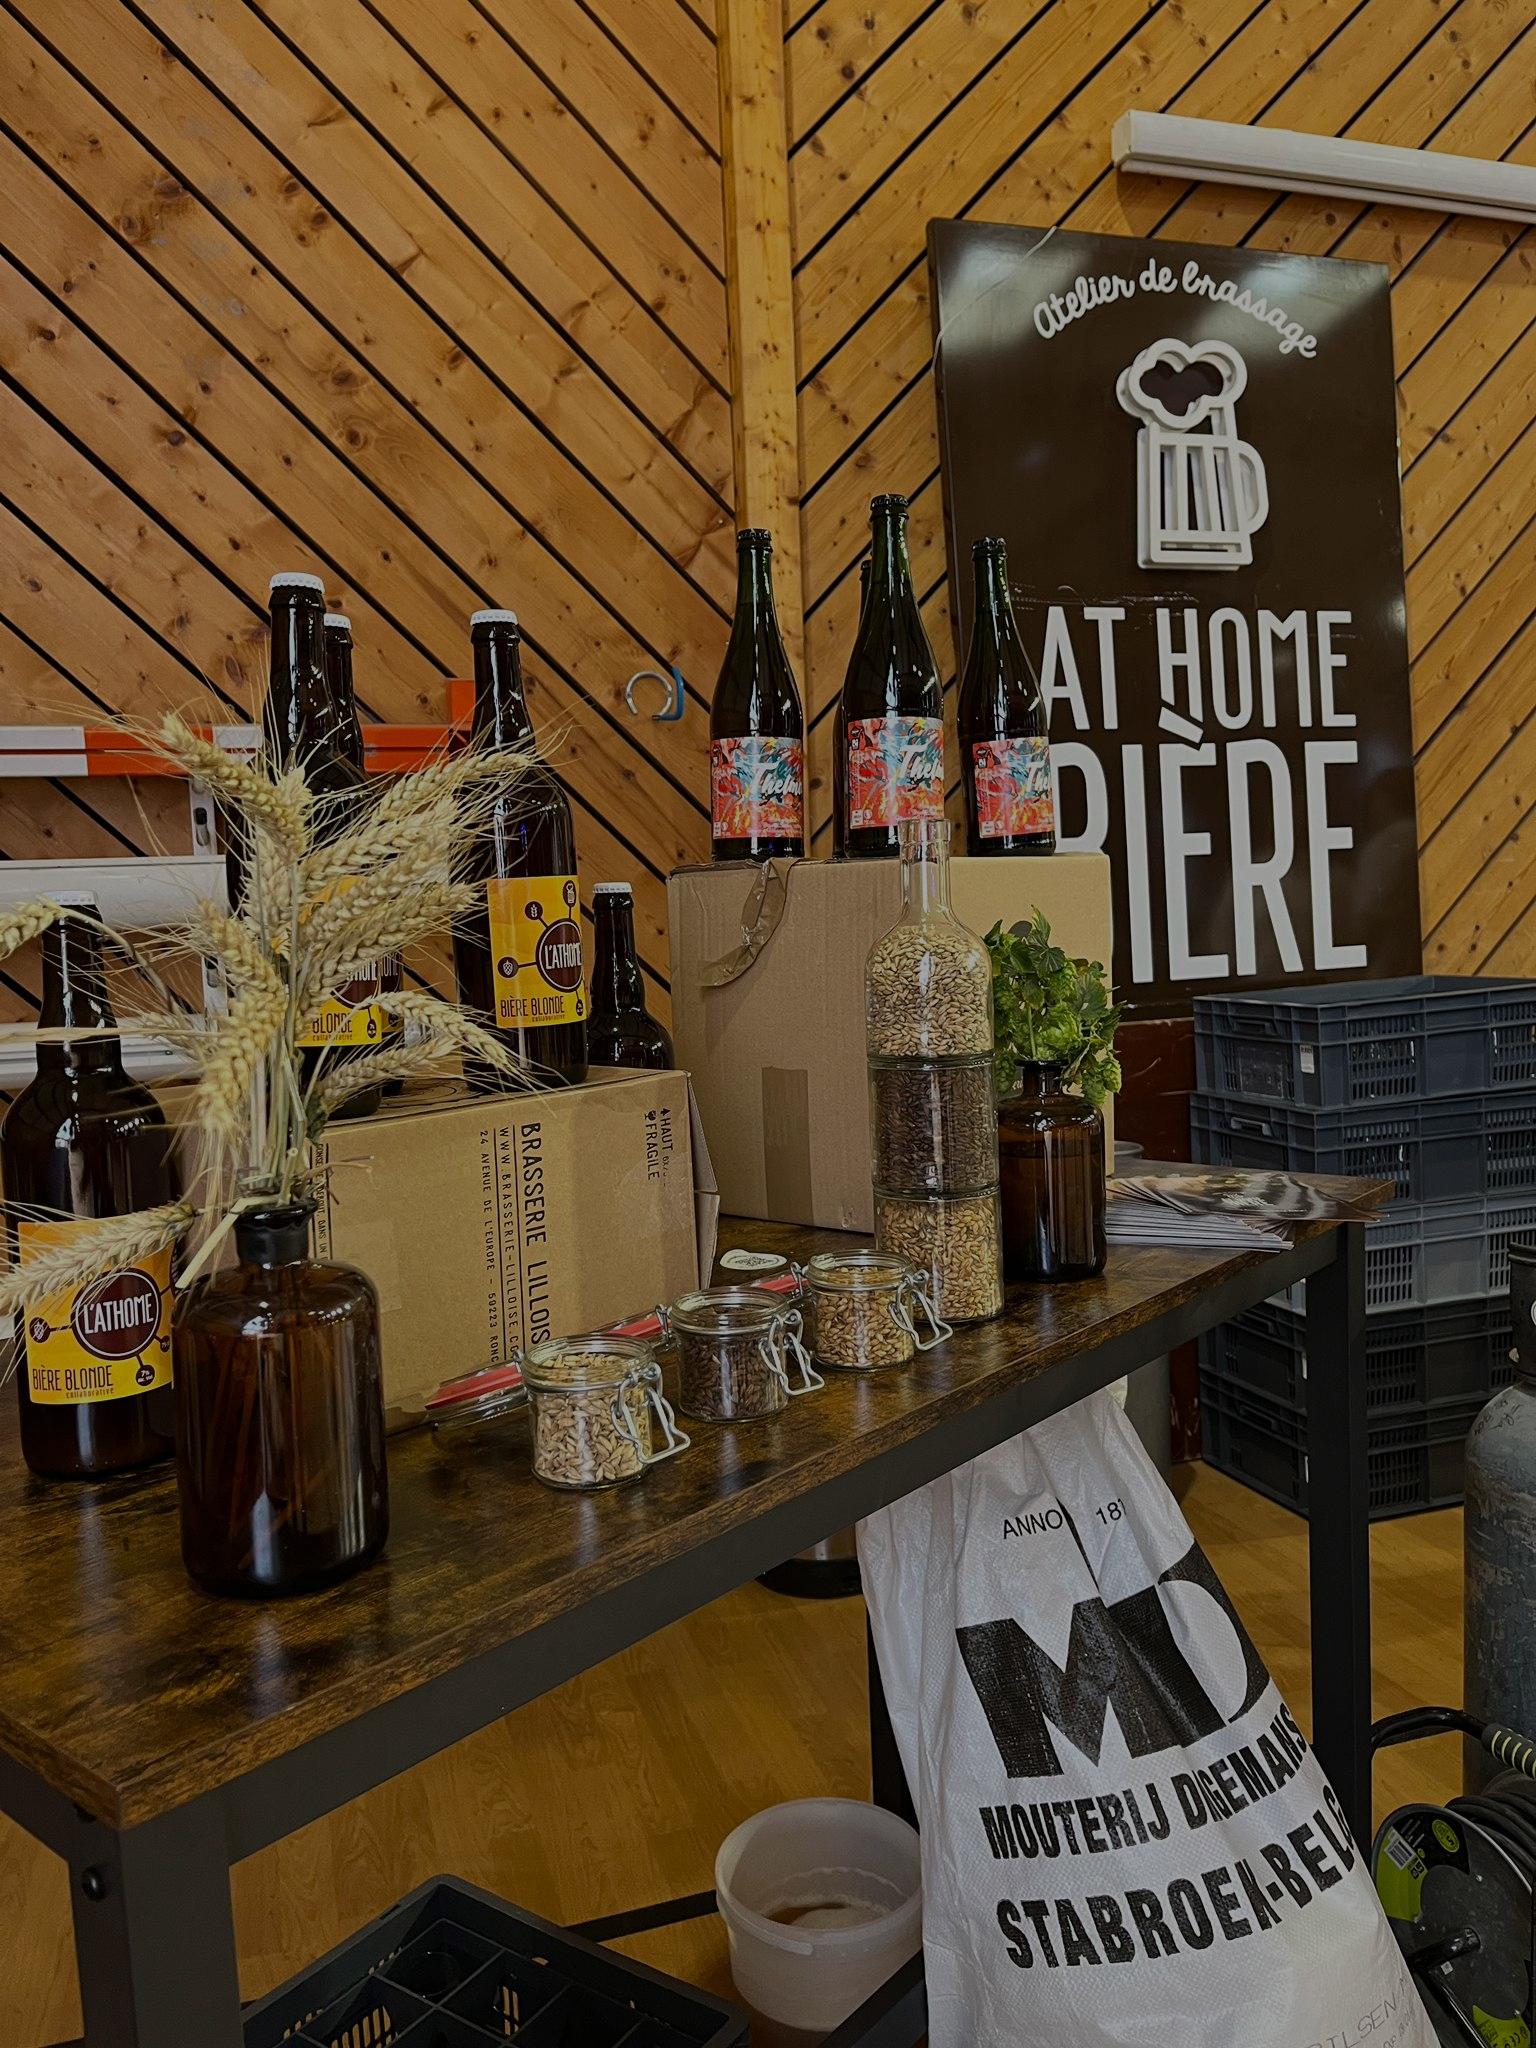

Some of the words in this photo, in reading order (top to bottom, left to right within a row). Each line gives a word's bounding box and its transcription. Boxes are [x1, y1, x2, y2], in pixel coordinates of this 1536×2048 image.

[1138, 257, 1178, 293] de
[1181, 260, 1318, 359] brassage
[1039, 606, 1126, 731] AT
[1157, 605, 1358, 731] HOME
[544, 942, 582, 970] L'ATHOME
[500, 995, 528, 1018] BIÈRE
[531, 995, 565, 1017] BLONDE
[480, 1129, 489, 1145] 24
[645, 1122, 660, 1181] FRAGILE
[660, 1117, 674, 1151] HAUT
[481, 1152, 493, 1192] AVENUE
[520, 1122, 547, 1247] BRASSERIE
[483, 1199, 493, 1213] DE
[484, 1220, 496, 1271] L'EUROPE
[499, 1126, 520, 1358] WWW.BRASSERIE-LILLOISE.CO
[83, 1292, 154, 1335] L'ATHOME
[32, 1363, 62, 1391] BIÈRE
[65, 1364, 114, 1391] BLONDE
[1001, 1507, 1064, 1540] ANNO
[978, 1784, 1172, 1861] MOUTERIJ
[1305, 1991, 1397, 2048] ILSEN
